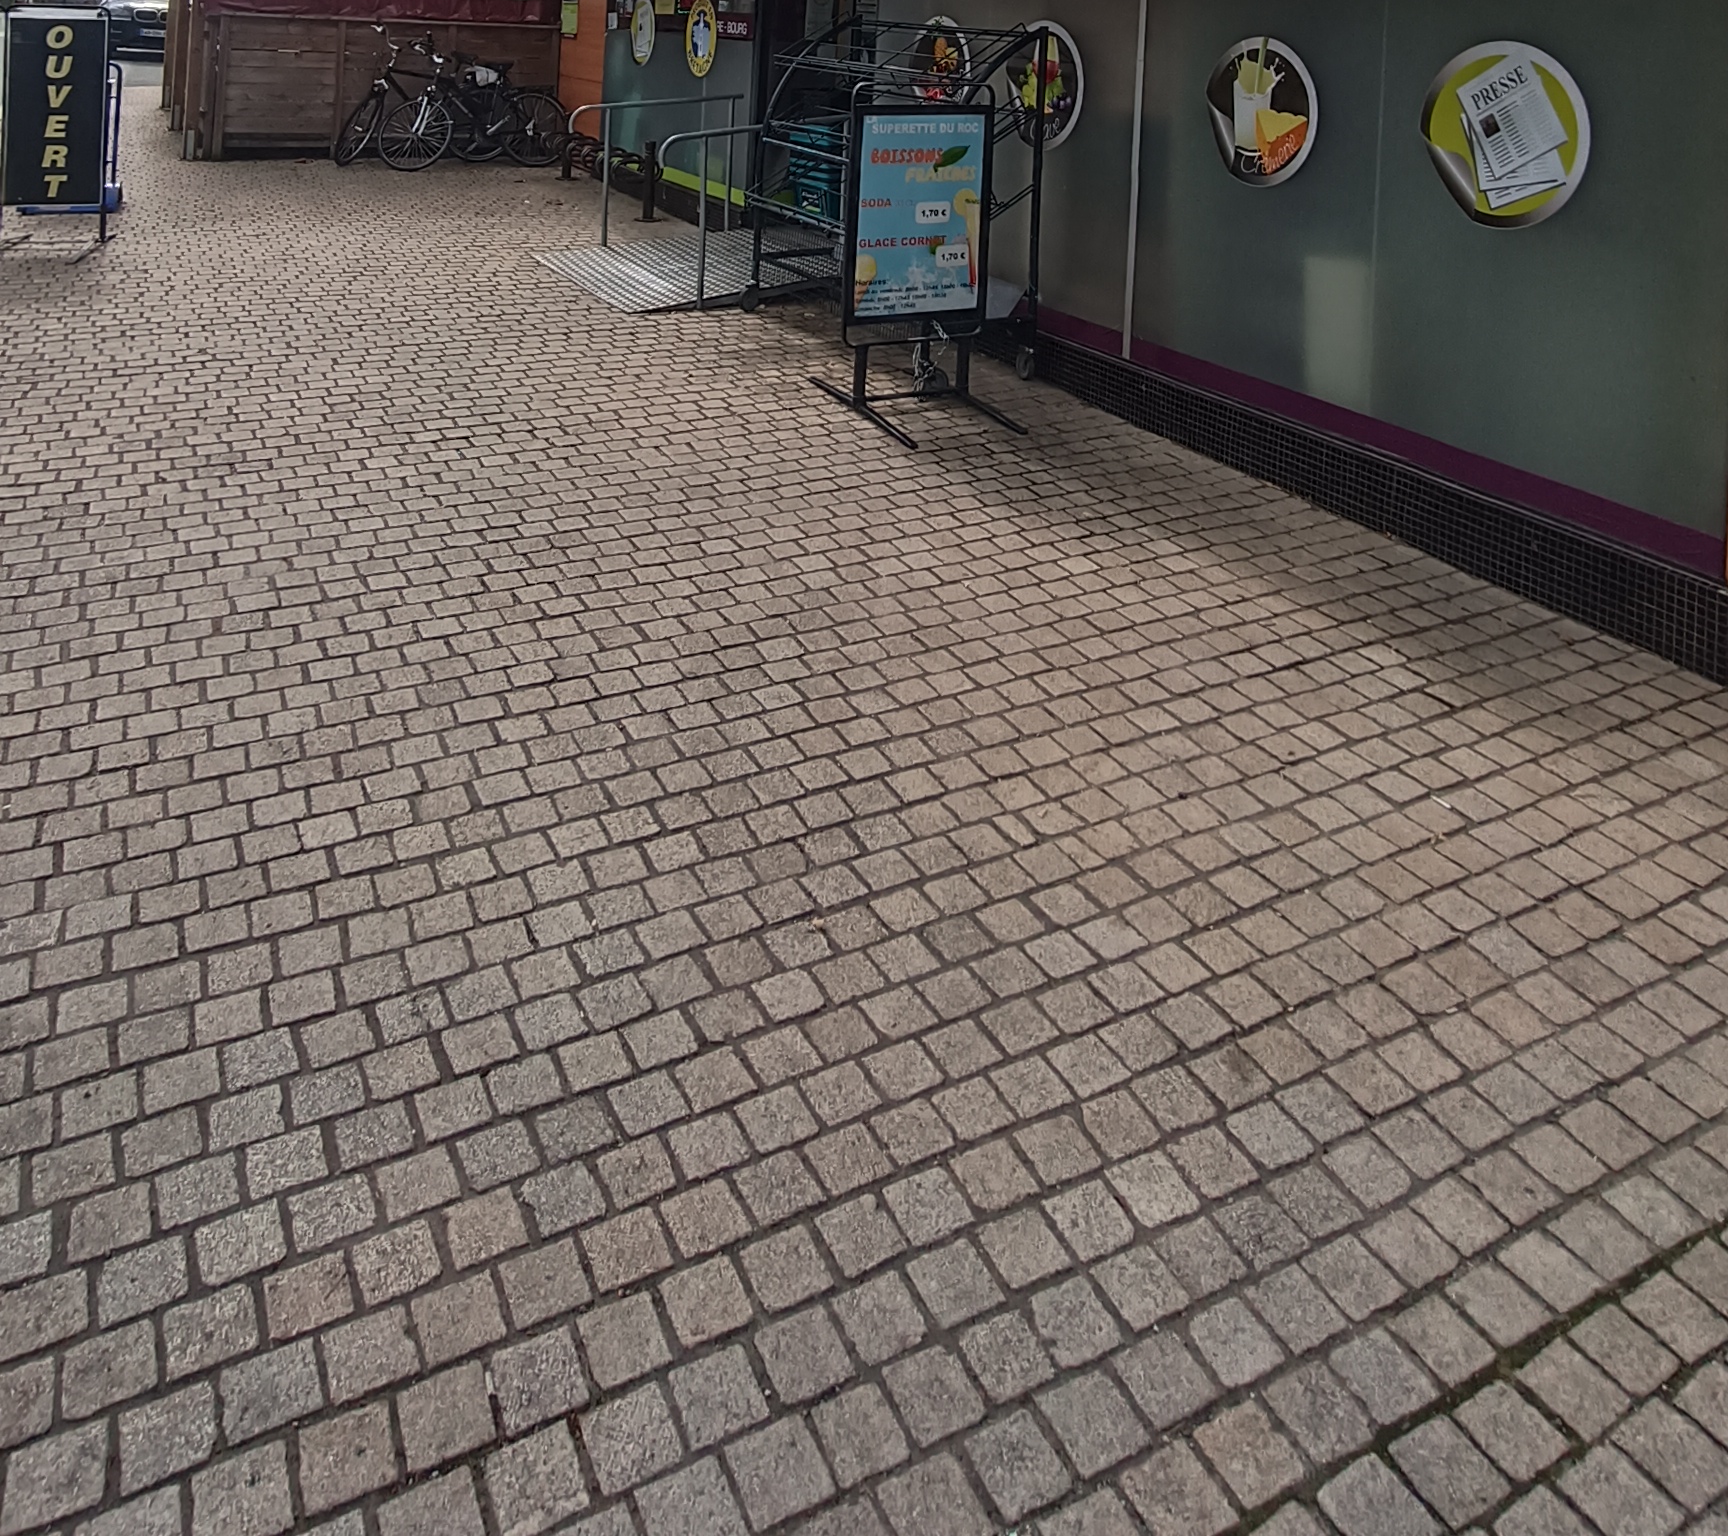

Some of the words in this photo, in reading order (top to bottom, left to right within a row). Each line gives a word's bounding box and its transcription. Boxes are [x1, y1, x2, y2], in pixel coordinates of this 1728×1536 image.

[1470, 65, 1529, 111] PRESSE
[41, 24, 74, 199] OUVERT
[872, 123, 937, 134] SUPERETTE
[939, 122, 955, 133] DU
[957, 122, 979, 133] ROC
[870, 147, 943, 164] BOISSONS
[860, 198, 892, 208] SODA
[858, 237, 897, 248] GLACE
[941, 252, 958, 262] 1,70
